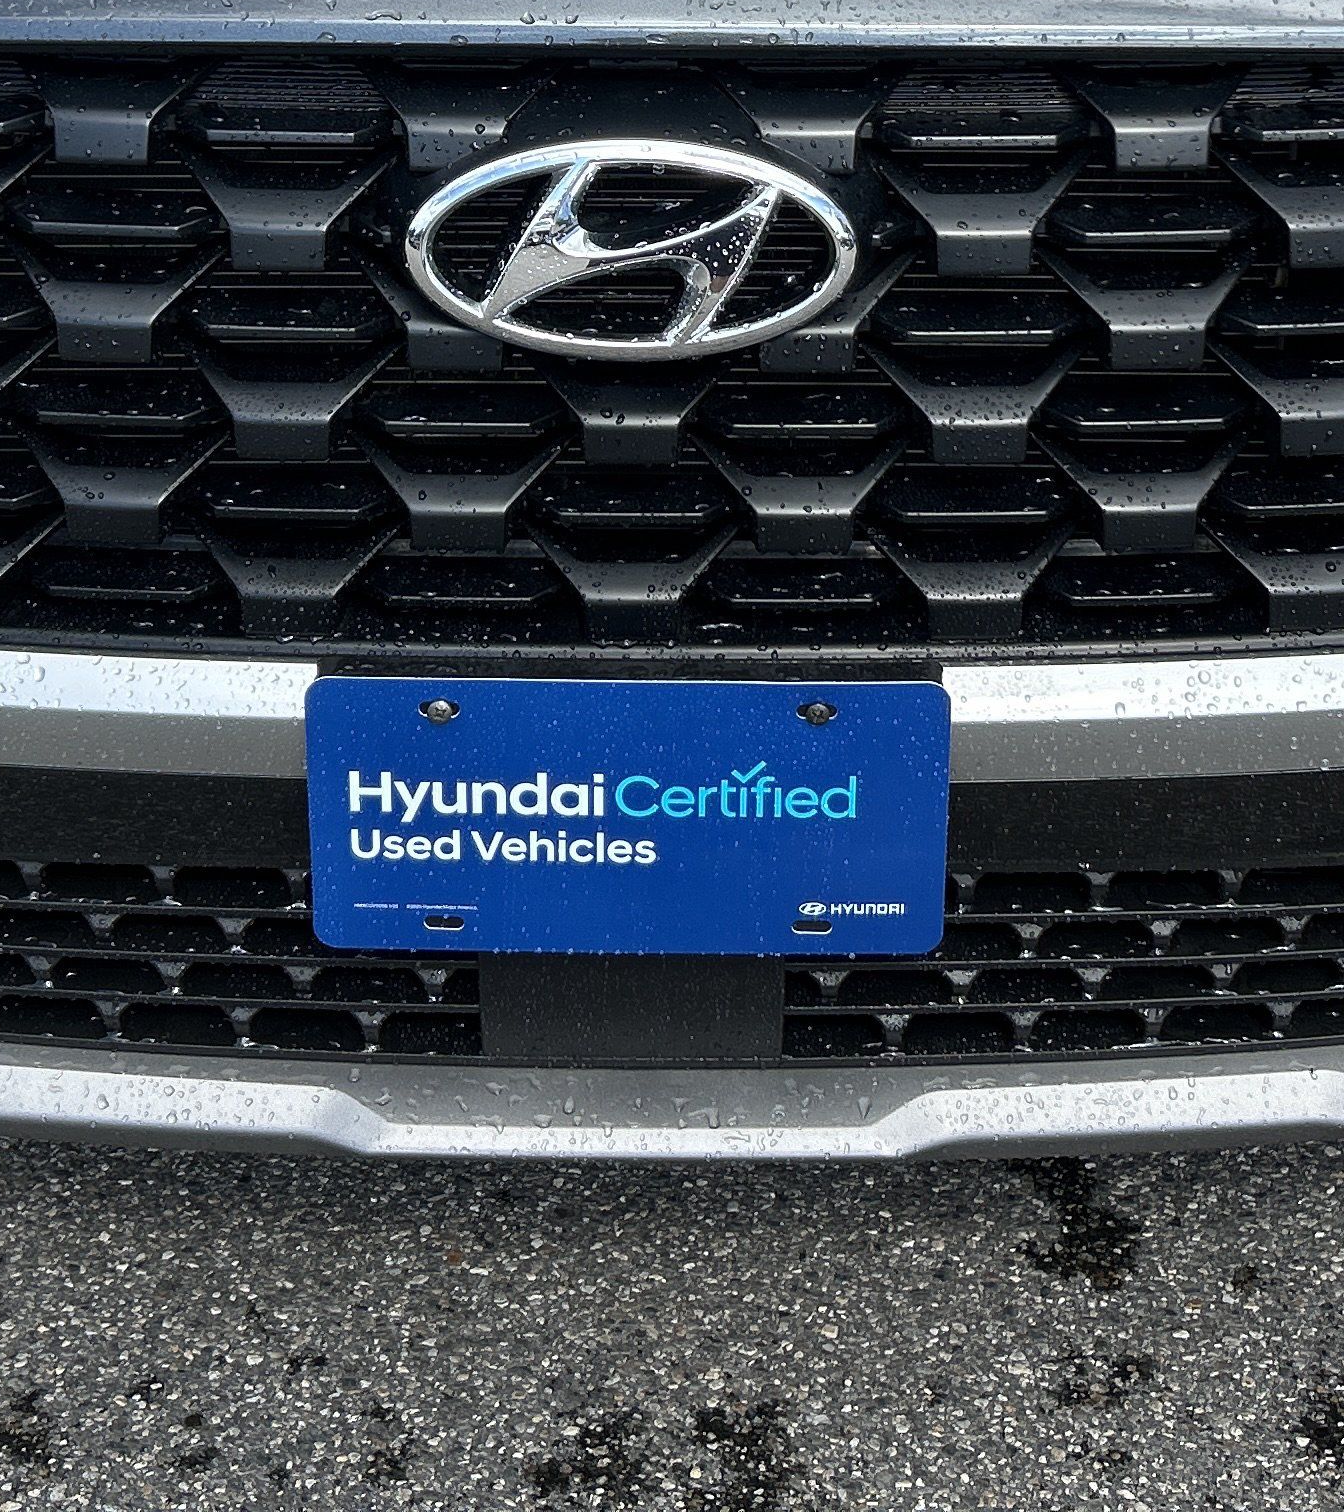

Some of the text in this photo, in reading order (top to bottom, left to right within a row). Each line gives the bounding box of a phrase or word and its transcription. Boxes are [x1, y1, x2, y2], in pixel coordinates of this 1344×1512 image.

[349, 760, 856, 823] Hyundai Certified
[350, 828, 657, 864] Used Vehicles
[830, 903, 905, 915] HYUNDAI
